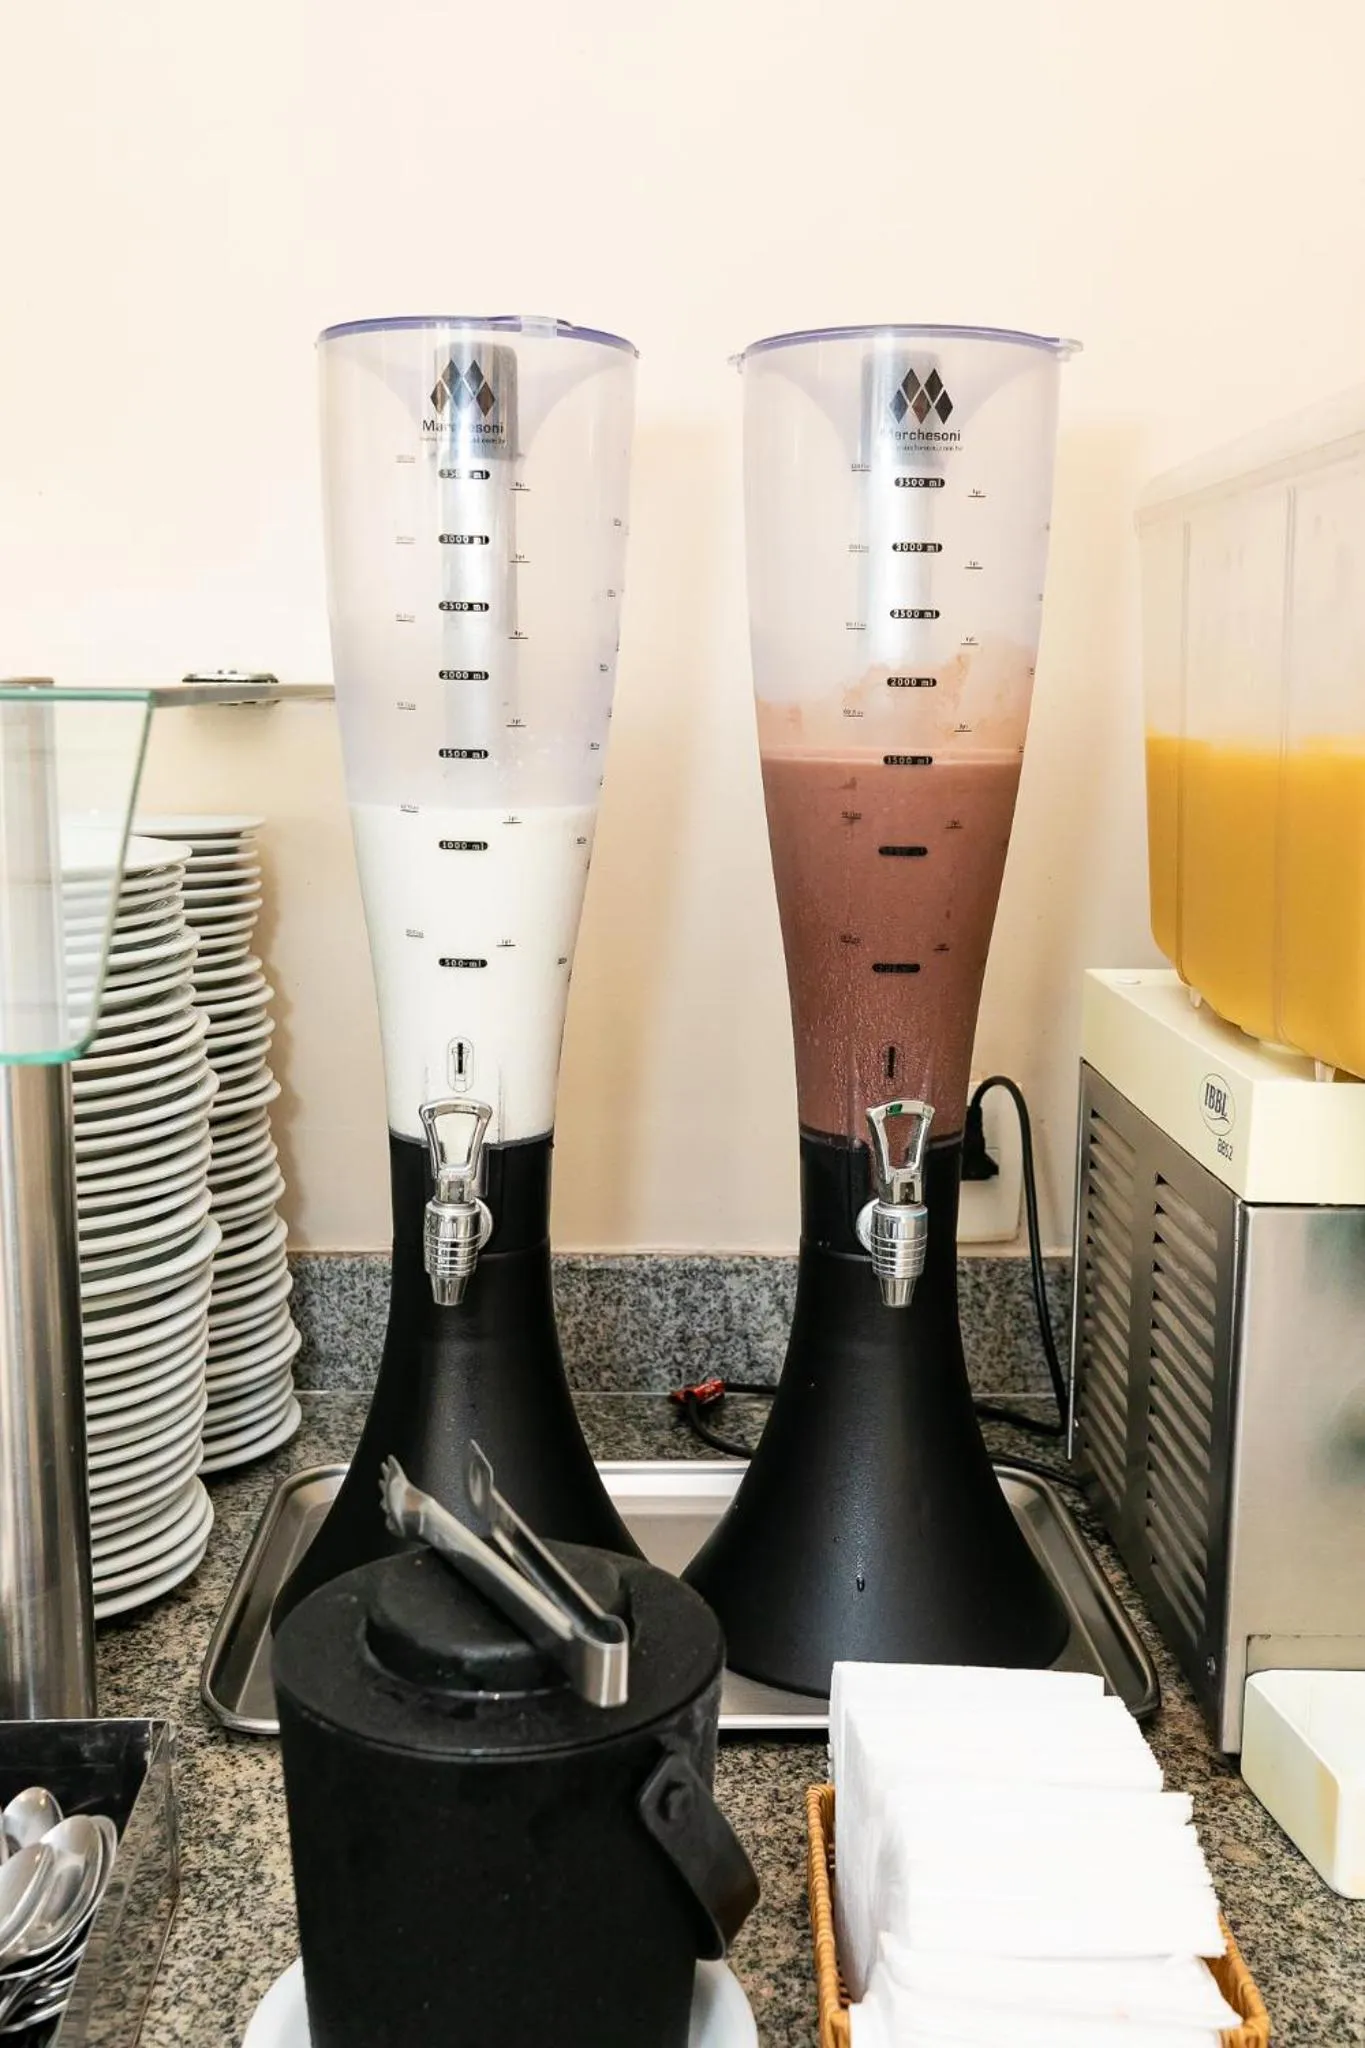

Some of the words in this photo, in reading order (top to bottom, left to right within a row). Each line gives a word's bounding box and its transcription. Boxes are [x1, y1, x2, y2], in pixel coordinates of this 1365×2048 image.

[879, 428, 961, 442] archesoni
[927, 478, 941, 488] ml
[442, 534, 469, 545] 3000
[894, 542, 922, 553] 3000
[925, 543, 939, 553] ml
[442, 601, 469, 612] 2500
[472, 603, 486, 612] ml
[892, 608, 920, 619] 2500
[923, 609, 937, 619] ml
[442, 670, 469, 680] 2000
[472, 671, 486, 681] ml
[889, 677, 917, 688] 2000
[919, 678, 934, 688] ml
[442, 749, 468, 759] 1500
[471, 750, 485, 760] ml
[886, 756, 913, 766] 1500
[915, 756, 929, 766] ml
[442, 840, 468, 850] 1000
[470, 842, 484, 851] ml
[444, 958, 464, 968] 500
[468, 959, 482, 969] ml
[1204, 1081, 1228, 1117] IBBL
